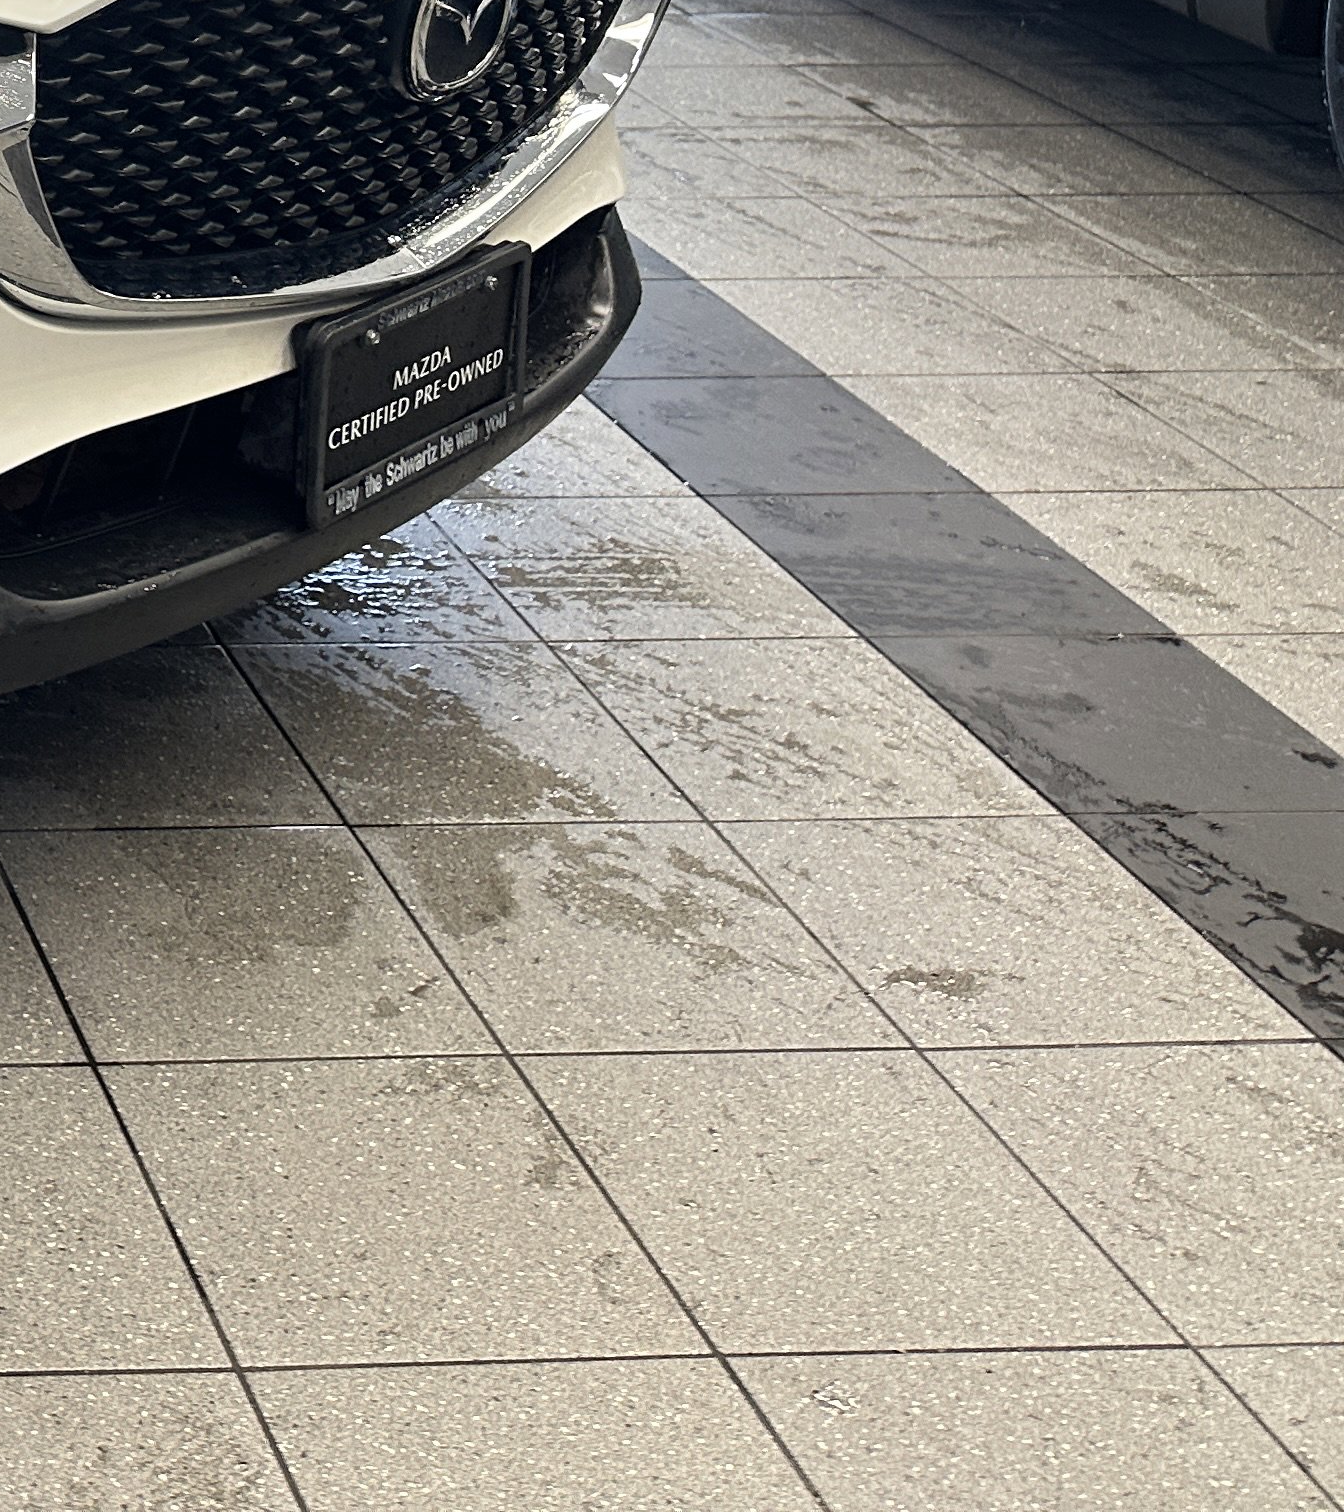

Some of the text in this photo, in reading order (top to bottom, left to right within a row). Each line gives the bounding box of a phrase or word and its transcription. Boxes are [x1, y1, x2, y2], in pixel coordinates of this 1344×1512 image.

[328, 348, 504, 450] CERTIFIED PRE-OWNED
[392, 345, 452, 391] MAZDA
[365, 473, 383, 498] the
[386, 442, 438, 486] Schwartz
[440, 435, 454, 458] be
